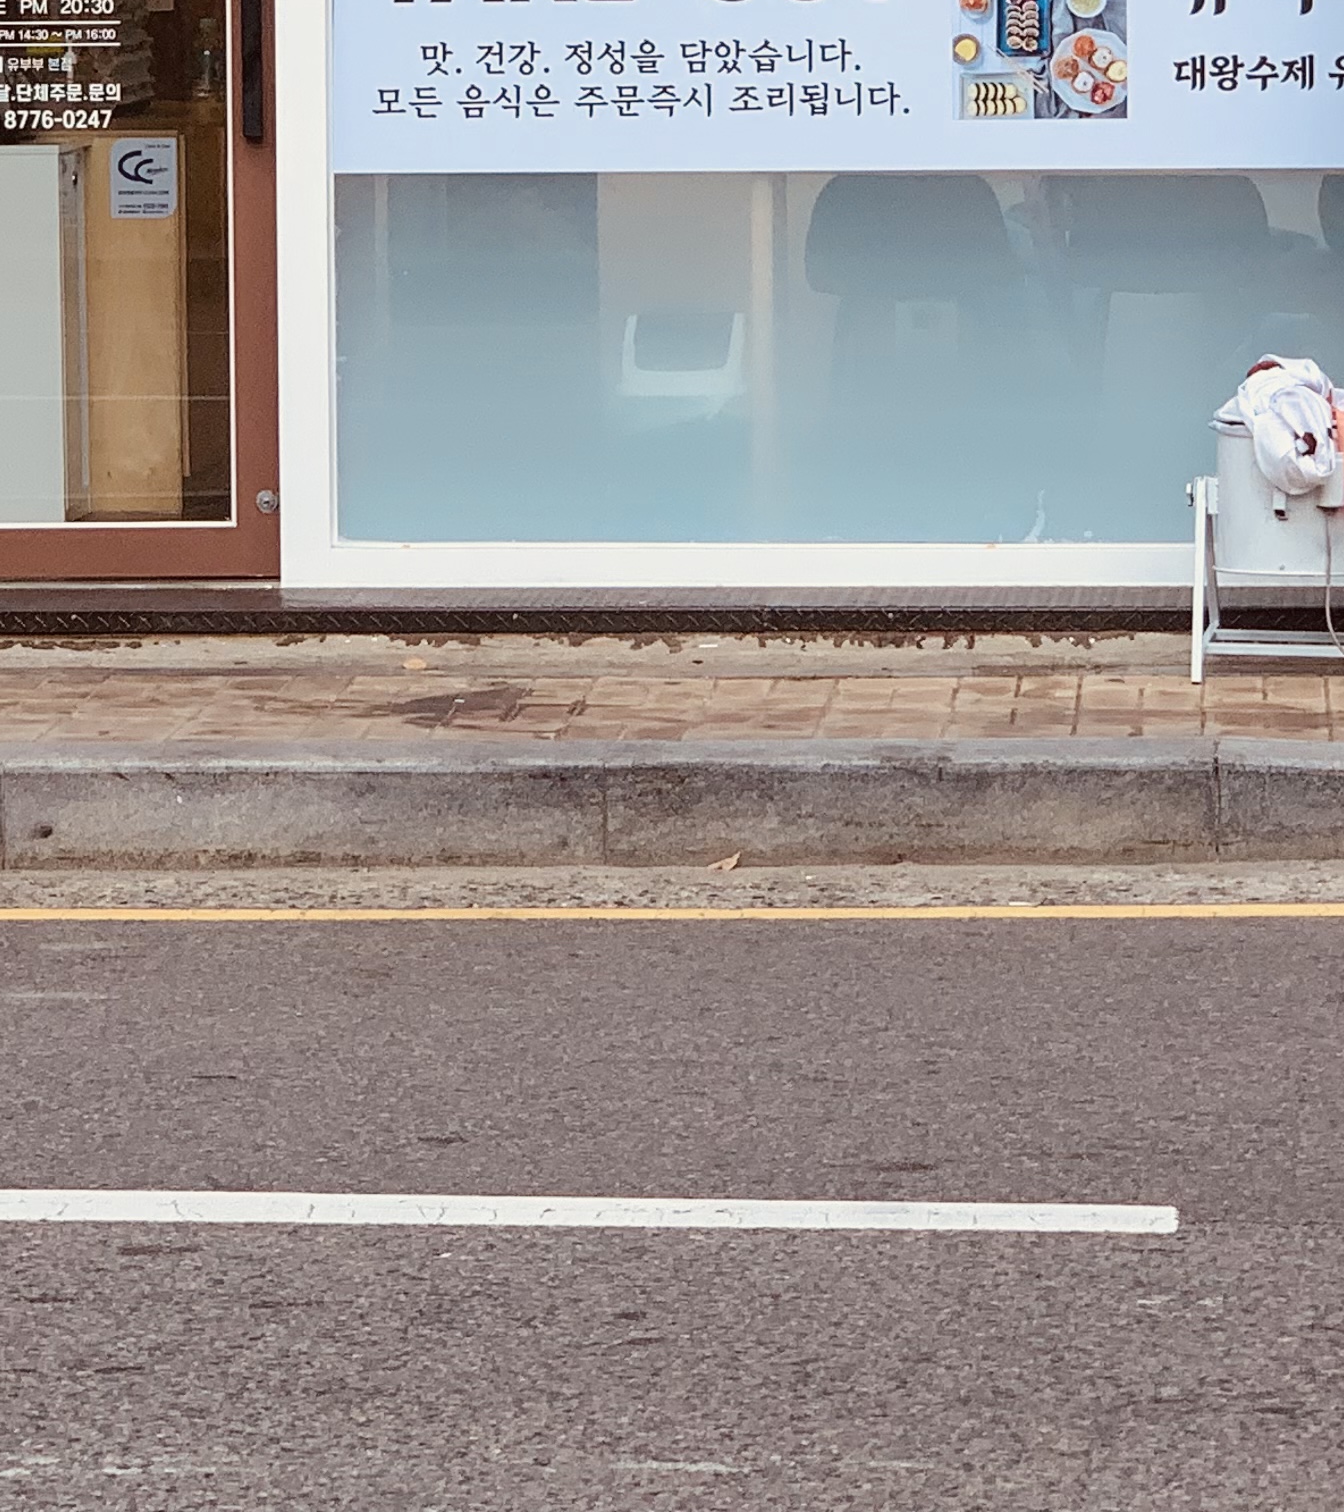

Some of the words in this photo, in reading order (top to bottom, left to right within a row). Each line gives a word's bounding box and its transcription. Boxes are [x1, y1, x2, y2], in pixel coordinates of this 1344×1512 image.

[19, 29, 48, 40] 14:30
[65, 29, 82, 40] PM
[86, 28, 116, 40] 16:00
[7, 58, 44, 71] 유부부
[420, 42, 462, 75] 맛.
[475, 41, 550, 75] 건강.
[565, 40, 664, 75] 정성을
[680, 39, 861, 74] 담았습니다.
[1173, 55, 1314, 91] 대왕수제
[372, 88, 443, 119] 모든
[456, 85, 560, 119] 음식은
[575, 85, 713, 118] 주문즉시
[729, 83, 910, 117] 조리됩니다.
[4, 110, 112, 130] 8776-0247
